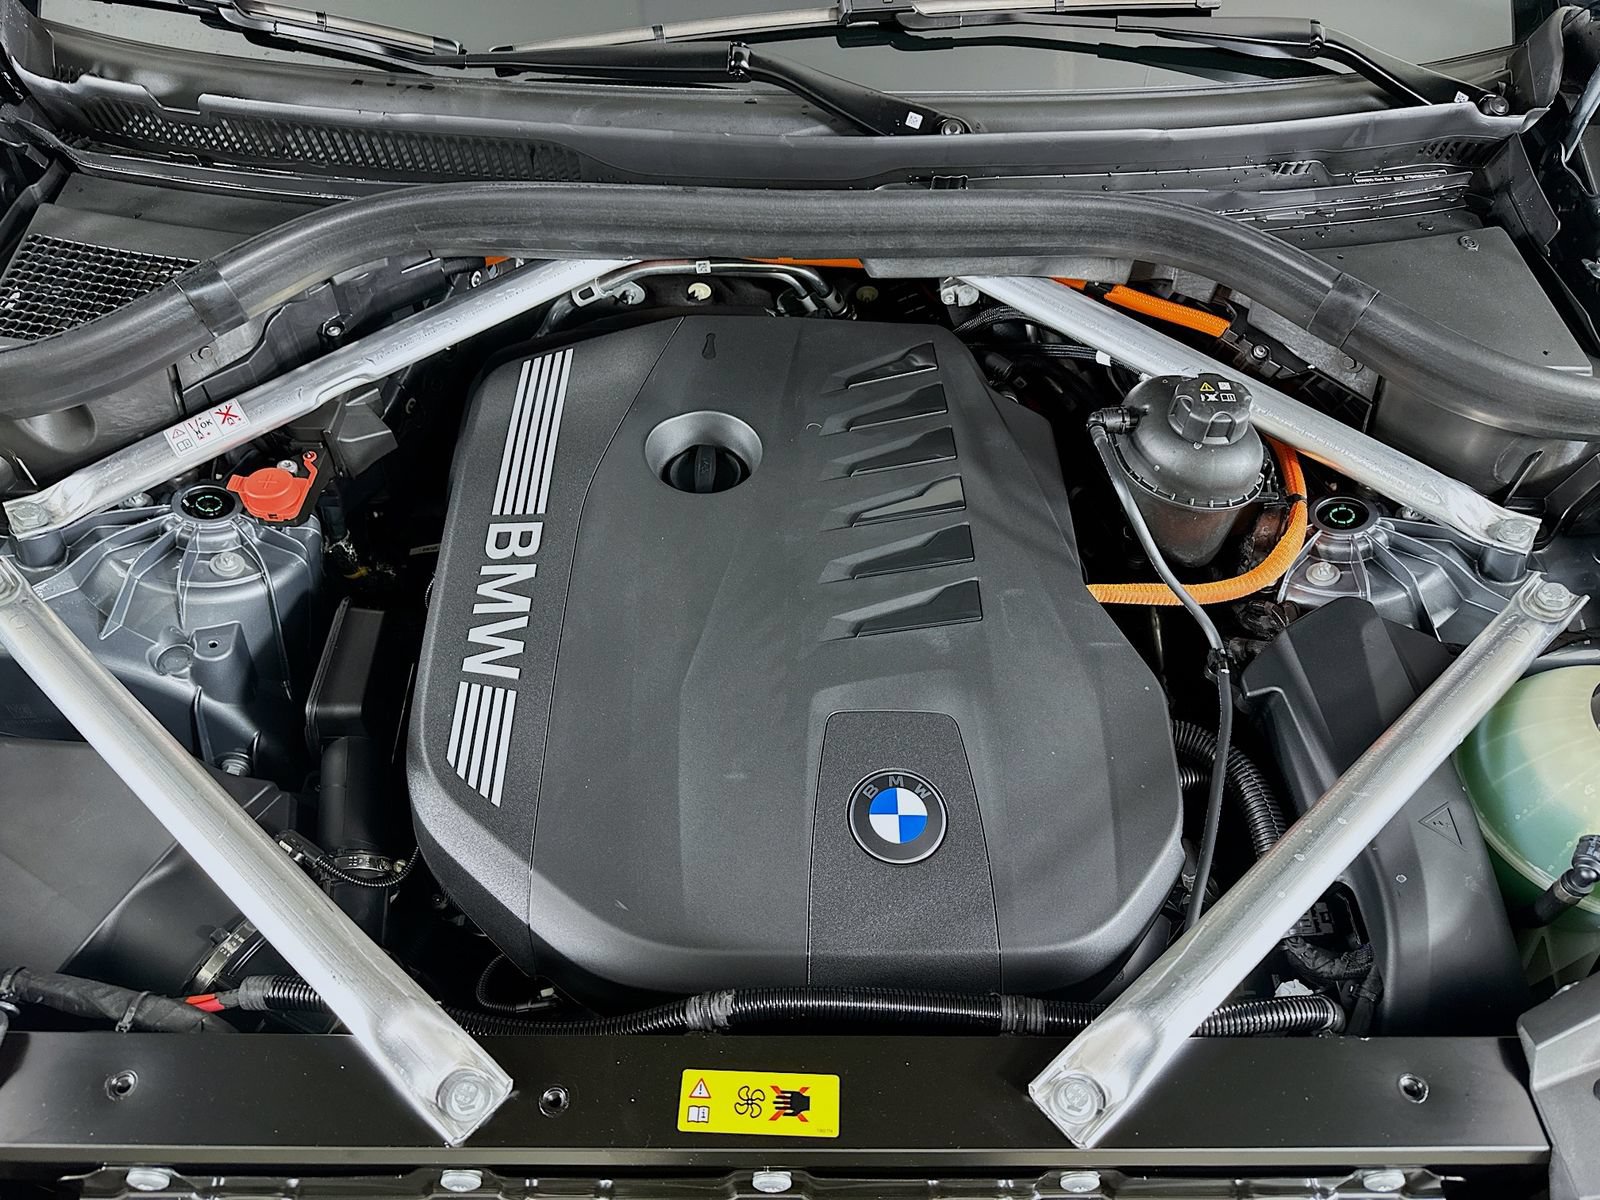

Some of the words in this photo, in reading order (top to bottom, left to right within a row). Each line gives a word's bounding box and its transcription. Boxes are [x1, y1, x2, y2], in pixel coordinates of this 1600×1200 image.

[200, 419, 213, 429] OK
[462, 522, 543, 679] BMW
[862, 775, 932, 800] BMW
